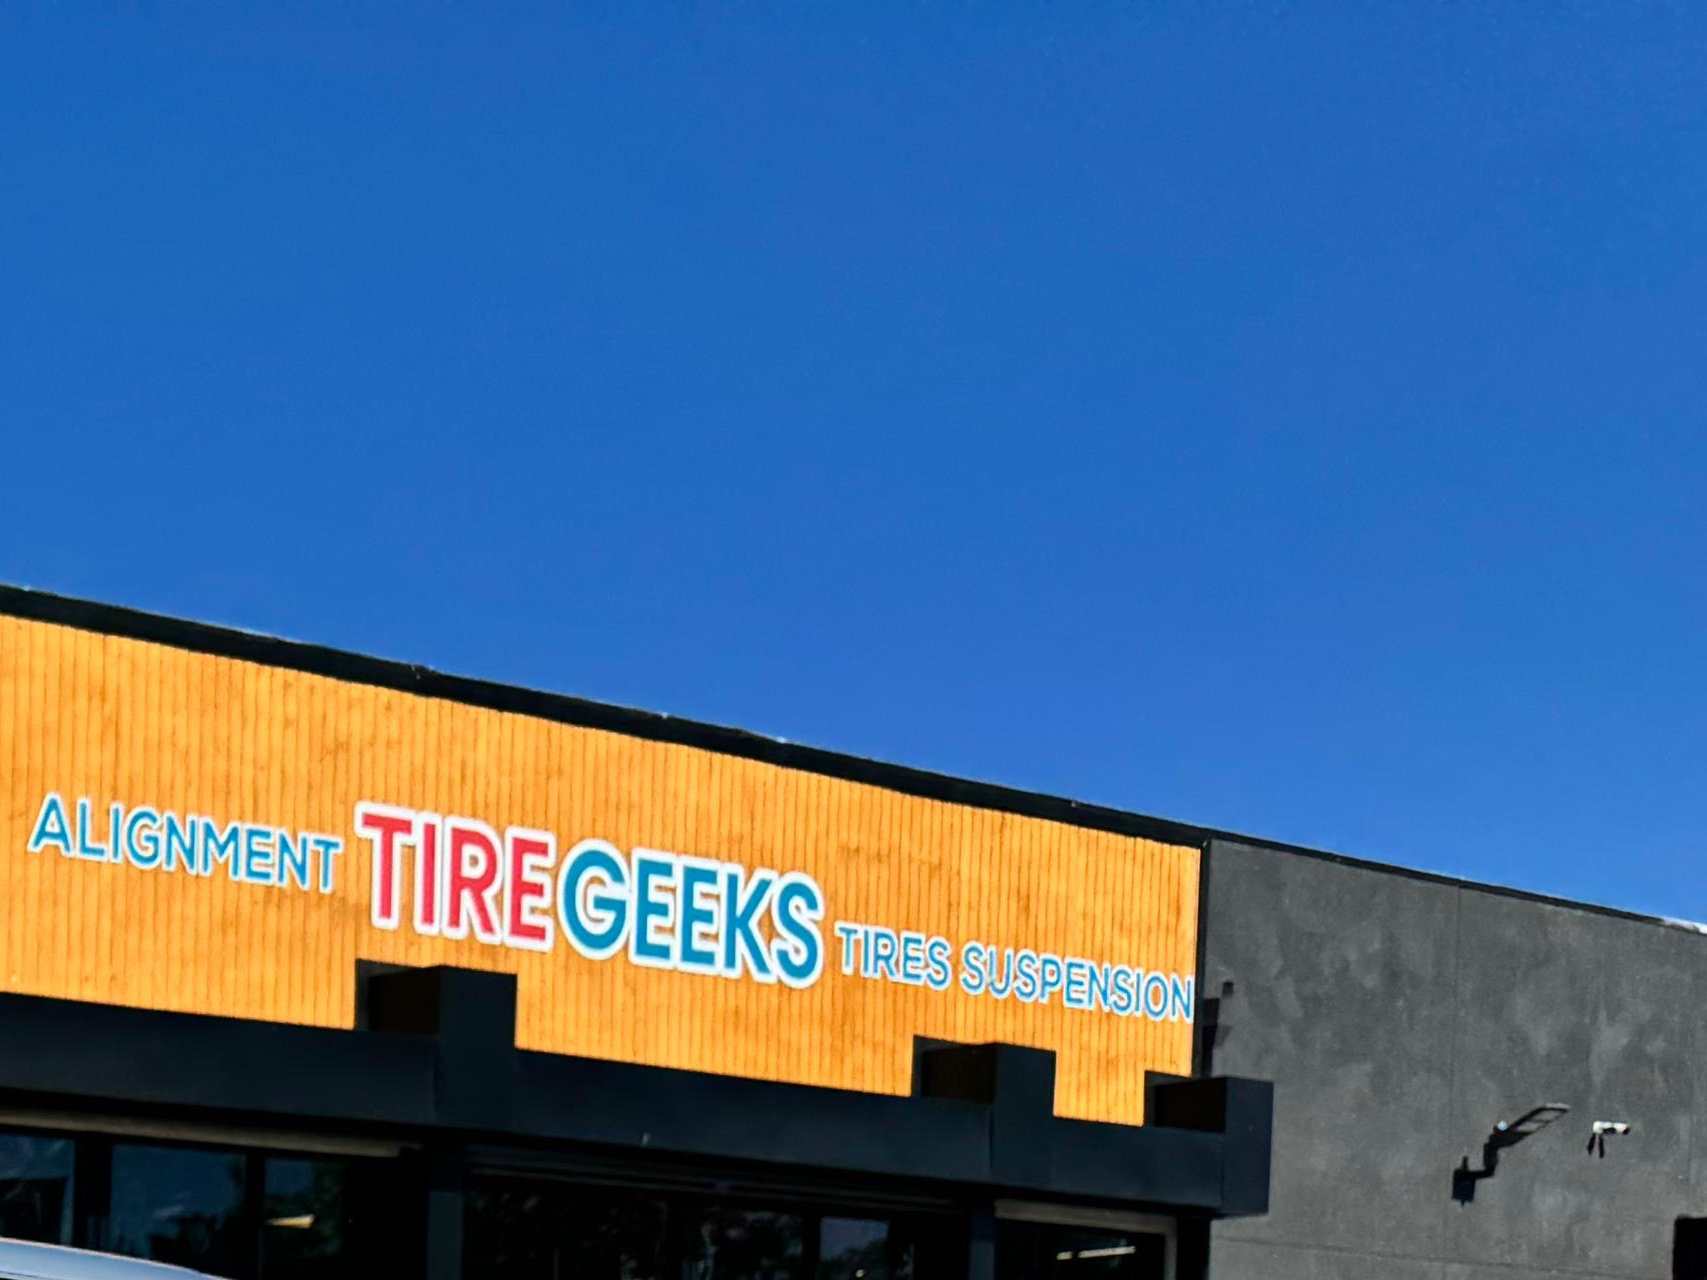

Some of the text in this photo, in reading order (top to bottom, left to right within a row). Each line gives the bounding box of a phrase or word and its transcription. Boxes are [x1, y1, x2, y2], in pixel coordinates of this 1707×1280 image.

[27, 793, 344, 893] ALIGNMENT
[834, 920, 951, 990] TIRES
[960, 940, 1195, 1024] SUSPENSION
